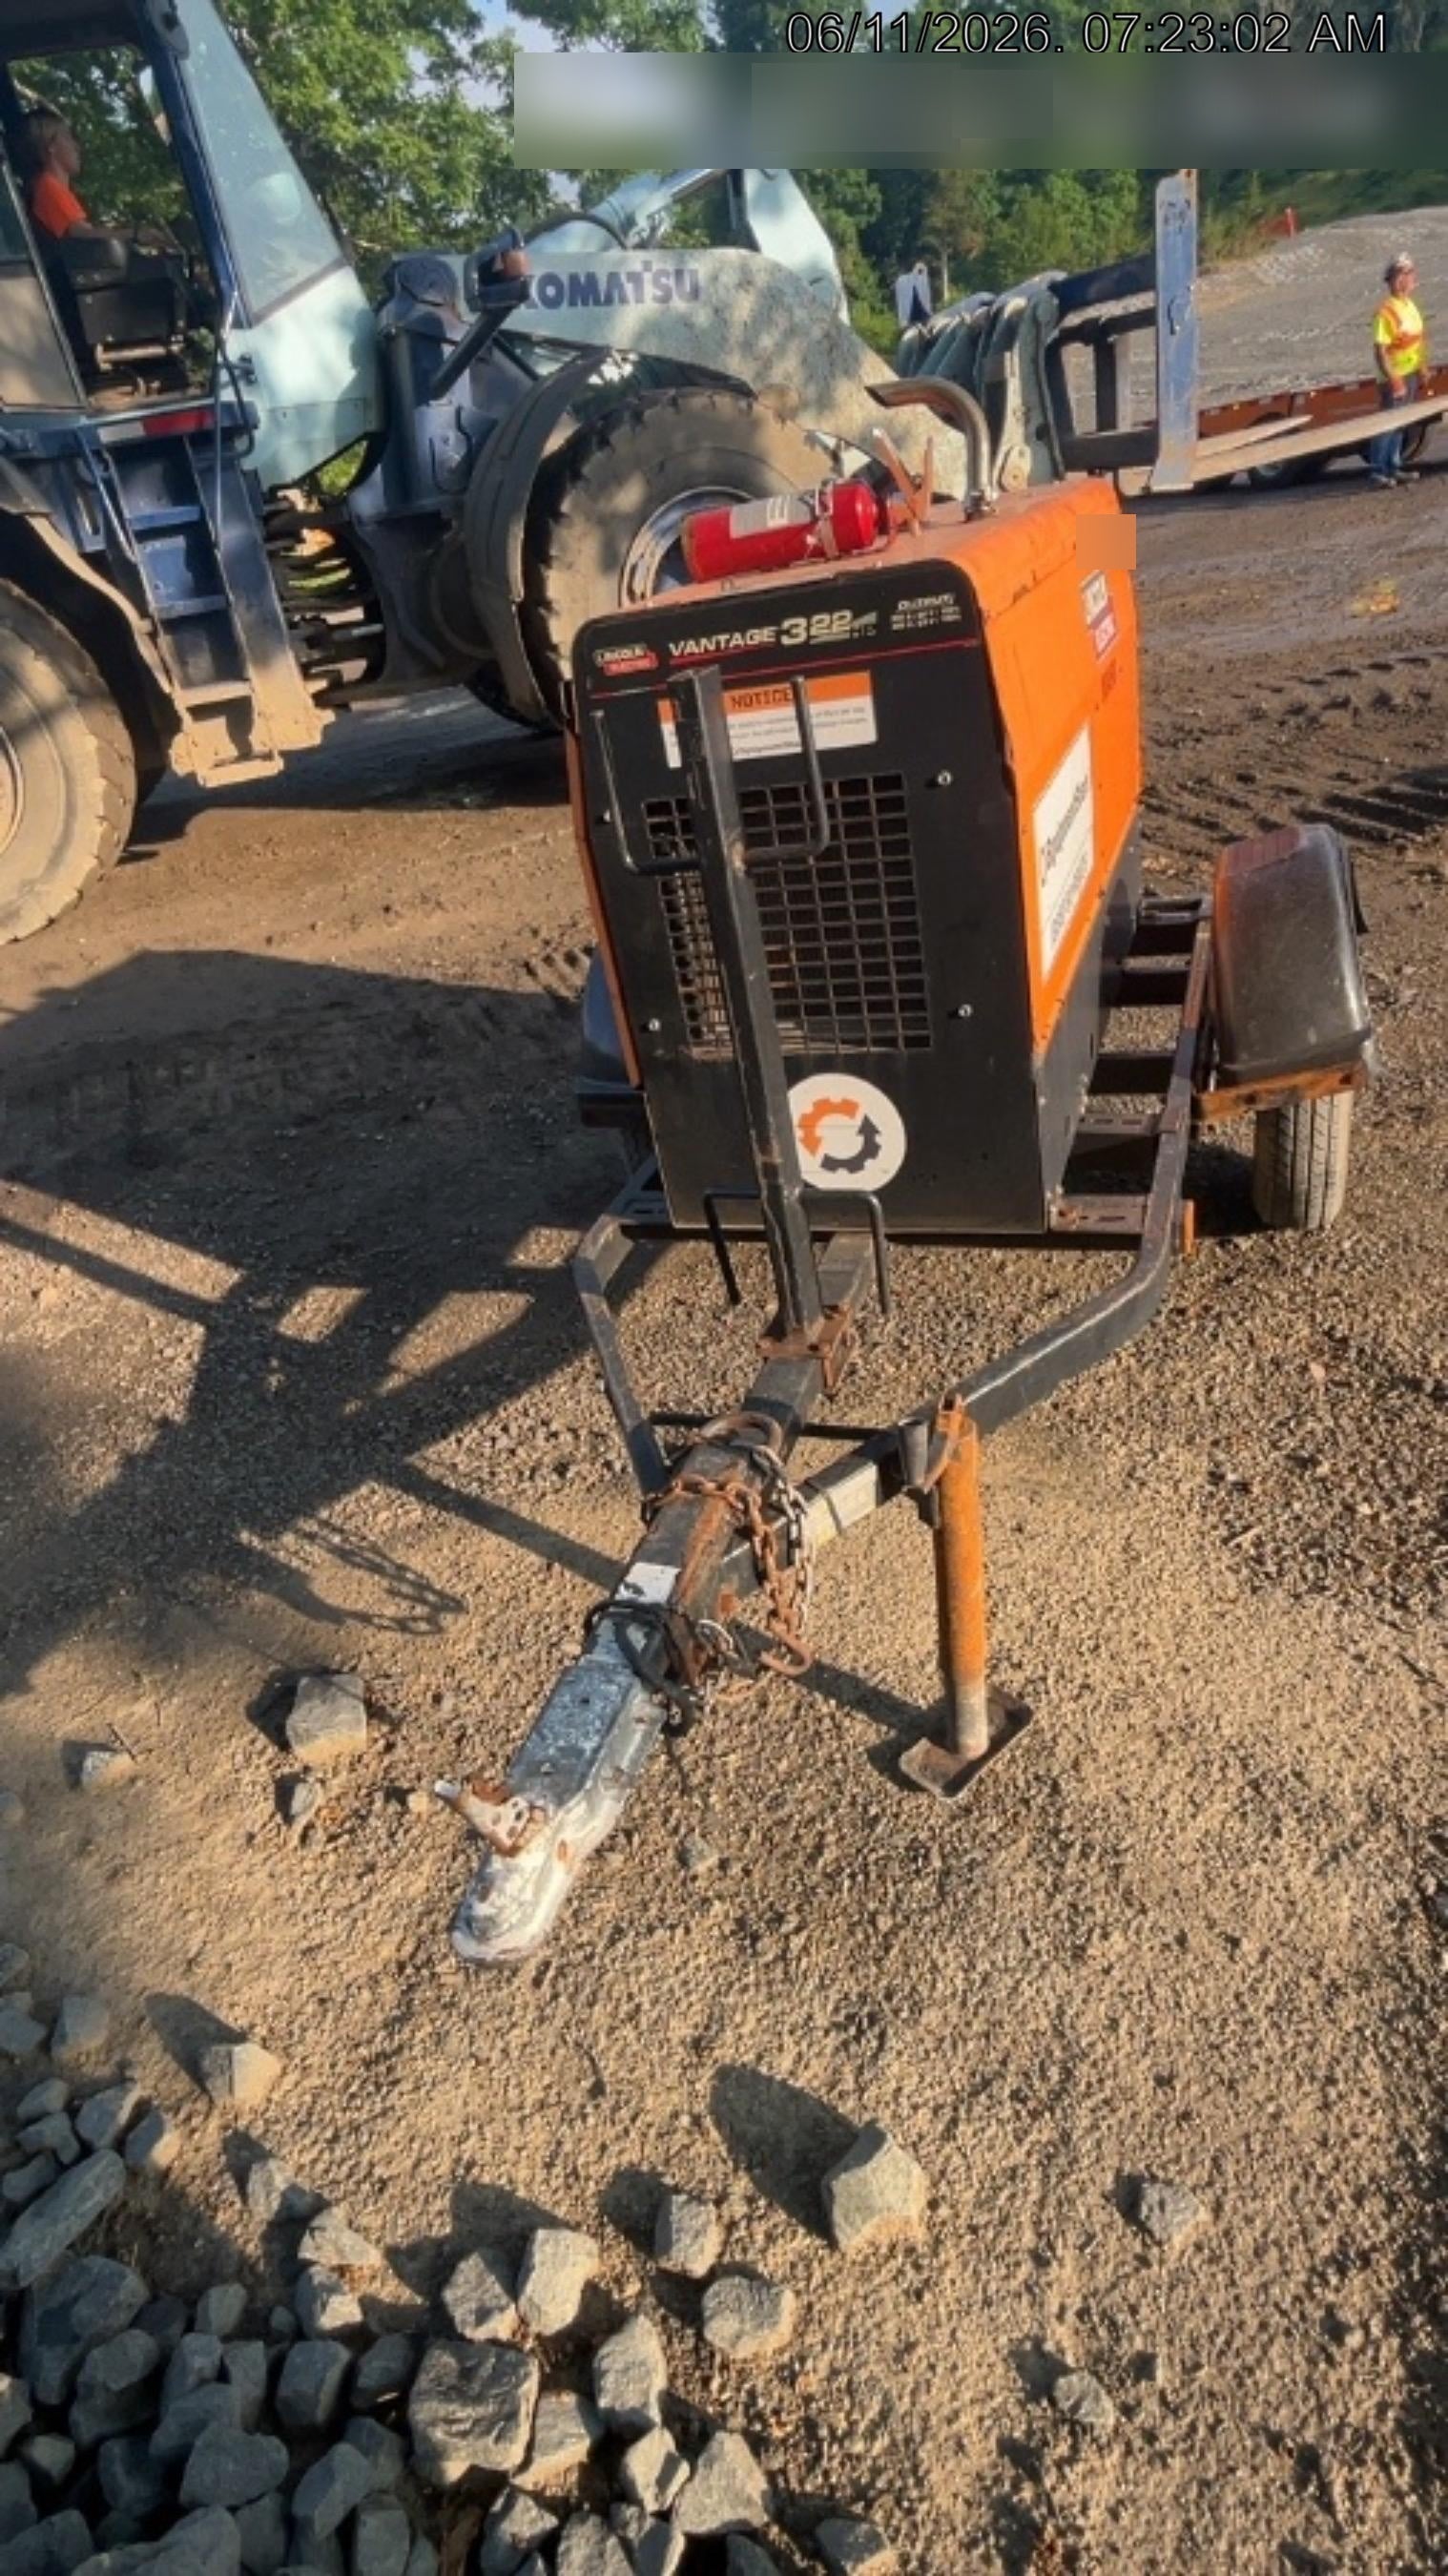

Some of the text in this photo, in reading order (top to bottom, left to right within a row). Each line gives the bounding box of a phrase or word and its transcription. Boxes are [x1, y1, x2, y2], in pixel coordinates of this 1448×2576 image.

[527, 260, 699, 309] OMATSU
[669, 625, 778, 657] VANTAGE
[780, 609, 854, 646] 322
[732, 687, 795, 708] NOTICE
